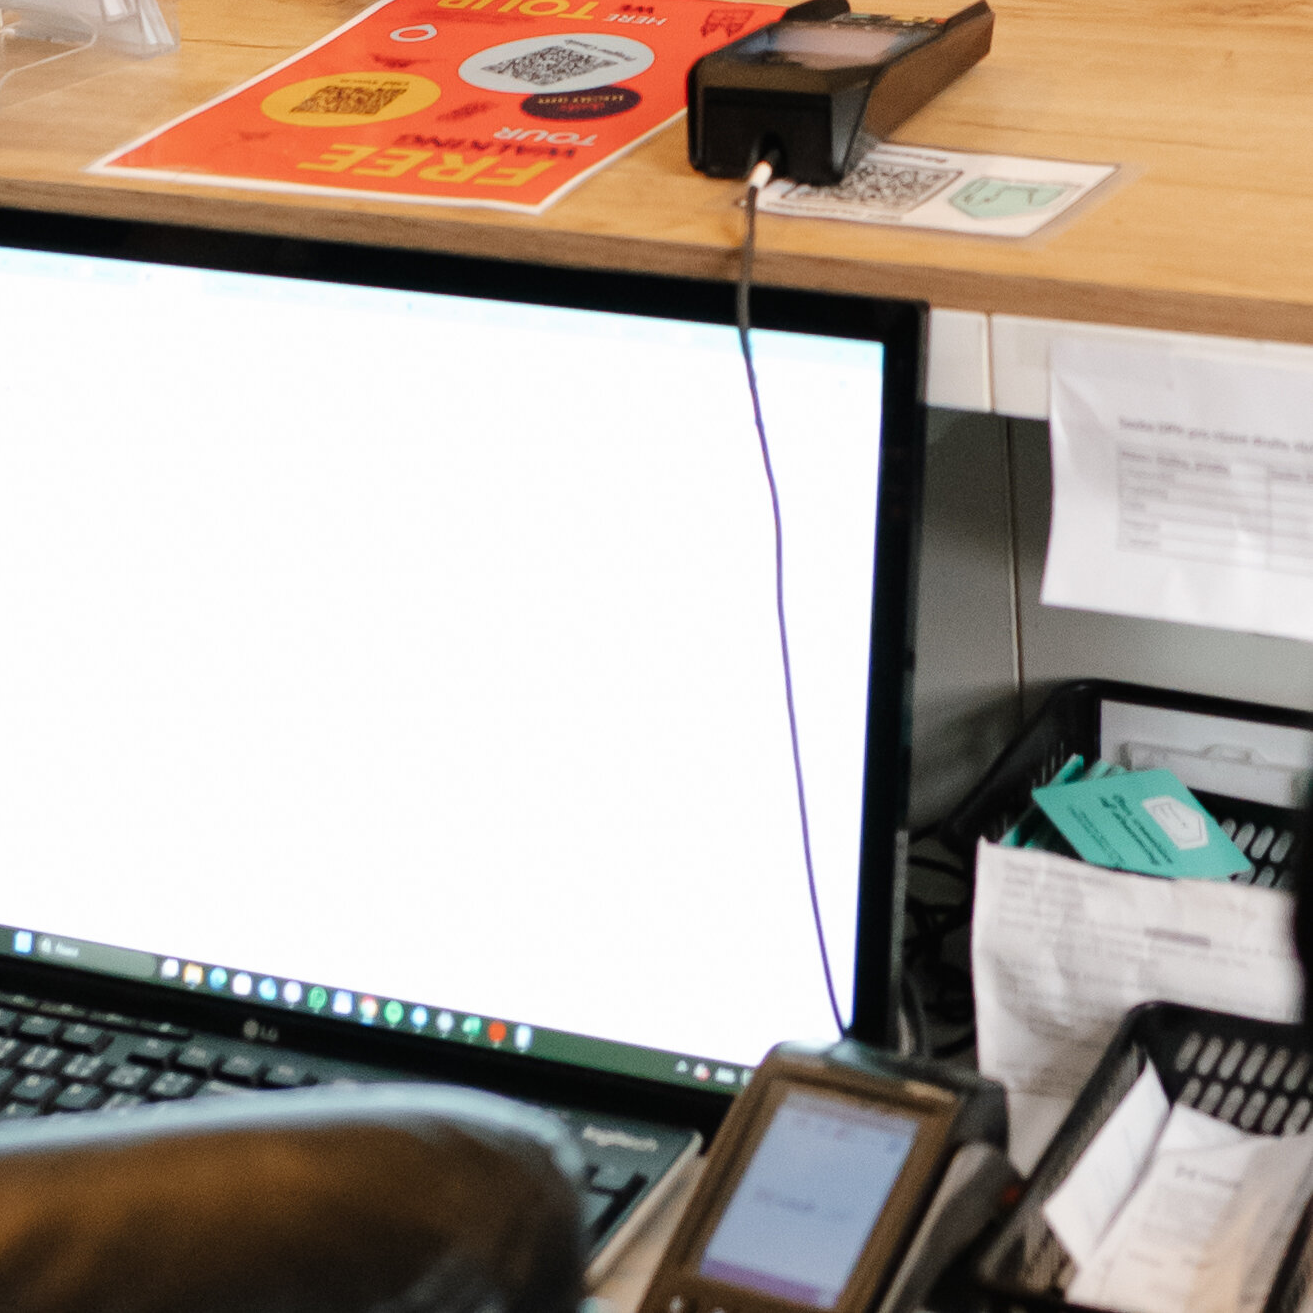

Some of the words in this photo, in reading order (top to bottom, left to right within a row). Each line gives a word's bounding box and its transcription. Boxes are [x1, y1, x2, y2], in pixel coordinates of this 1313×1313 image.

[604, 12, 668, 27] HERE
[390, 134, 577, 160] WALKING
[493, 126, 599, 147] TOUR
[295, 143, 556, 188] FREE
